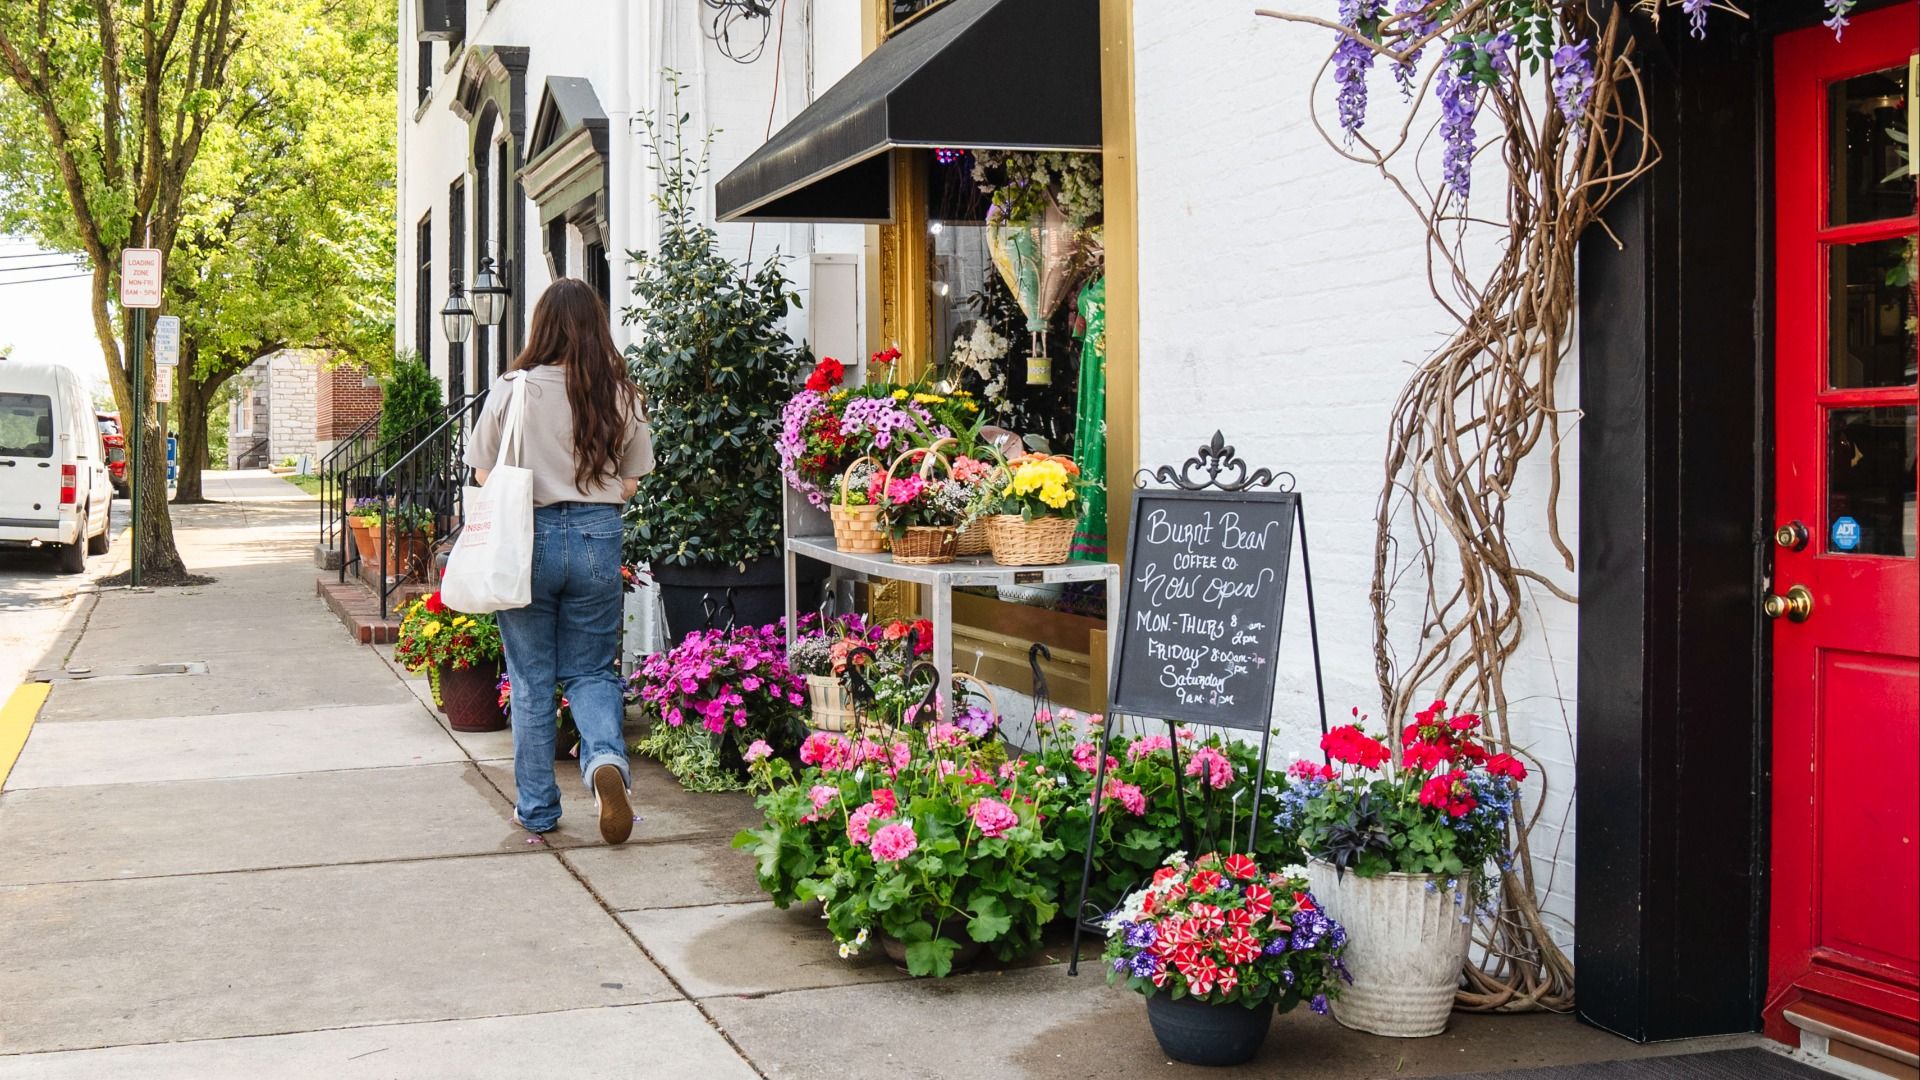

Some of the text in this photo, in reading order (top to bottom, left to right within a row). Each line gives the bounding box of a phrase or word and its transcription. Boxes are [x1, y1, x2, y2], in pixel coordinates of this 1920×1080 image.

[1836, 523, 1856, 535] ADT
[1173, 553, 1217, 570] COFFEE
[1160, 664, 1234, 694] Saturday
